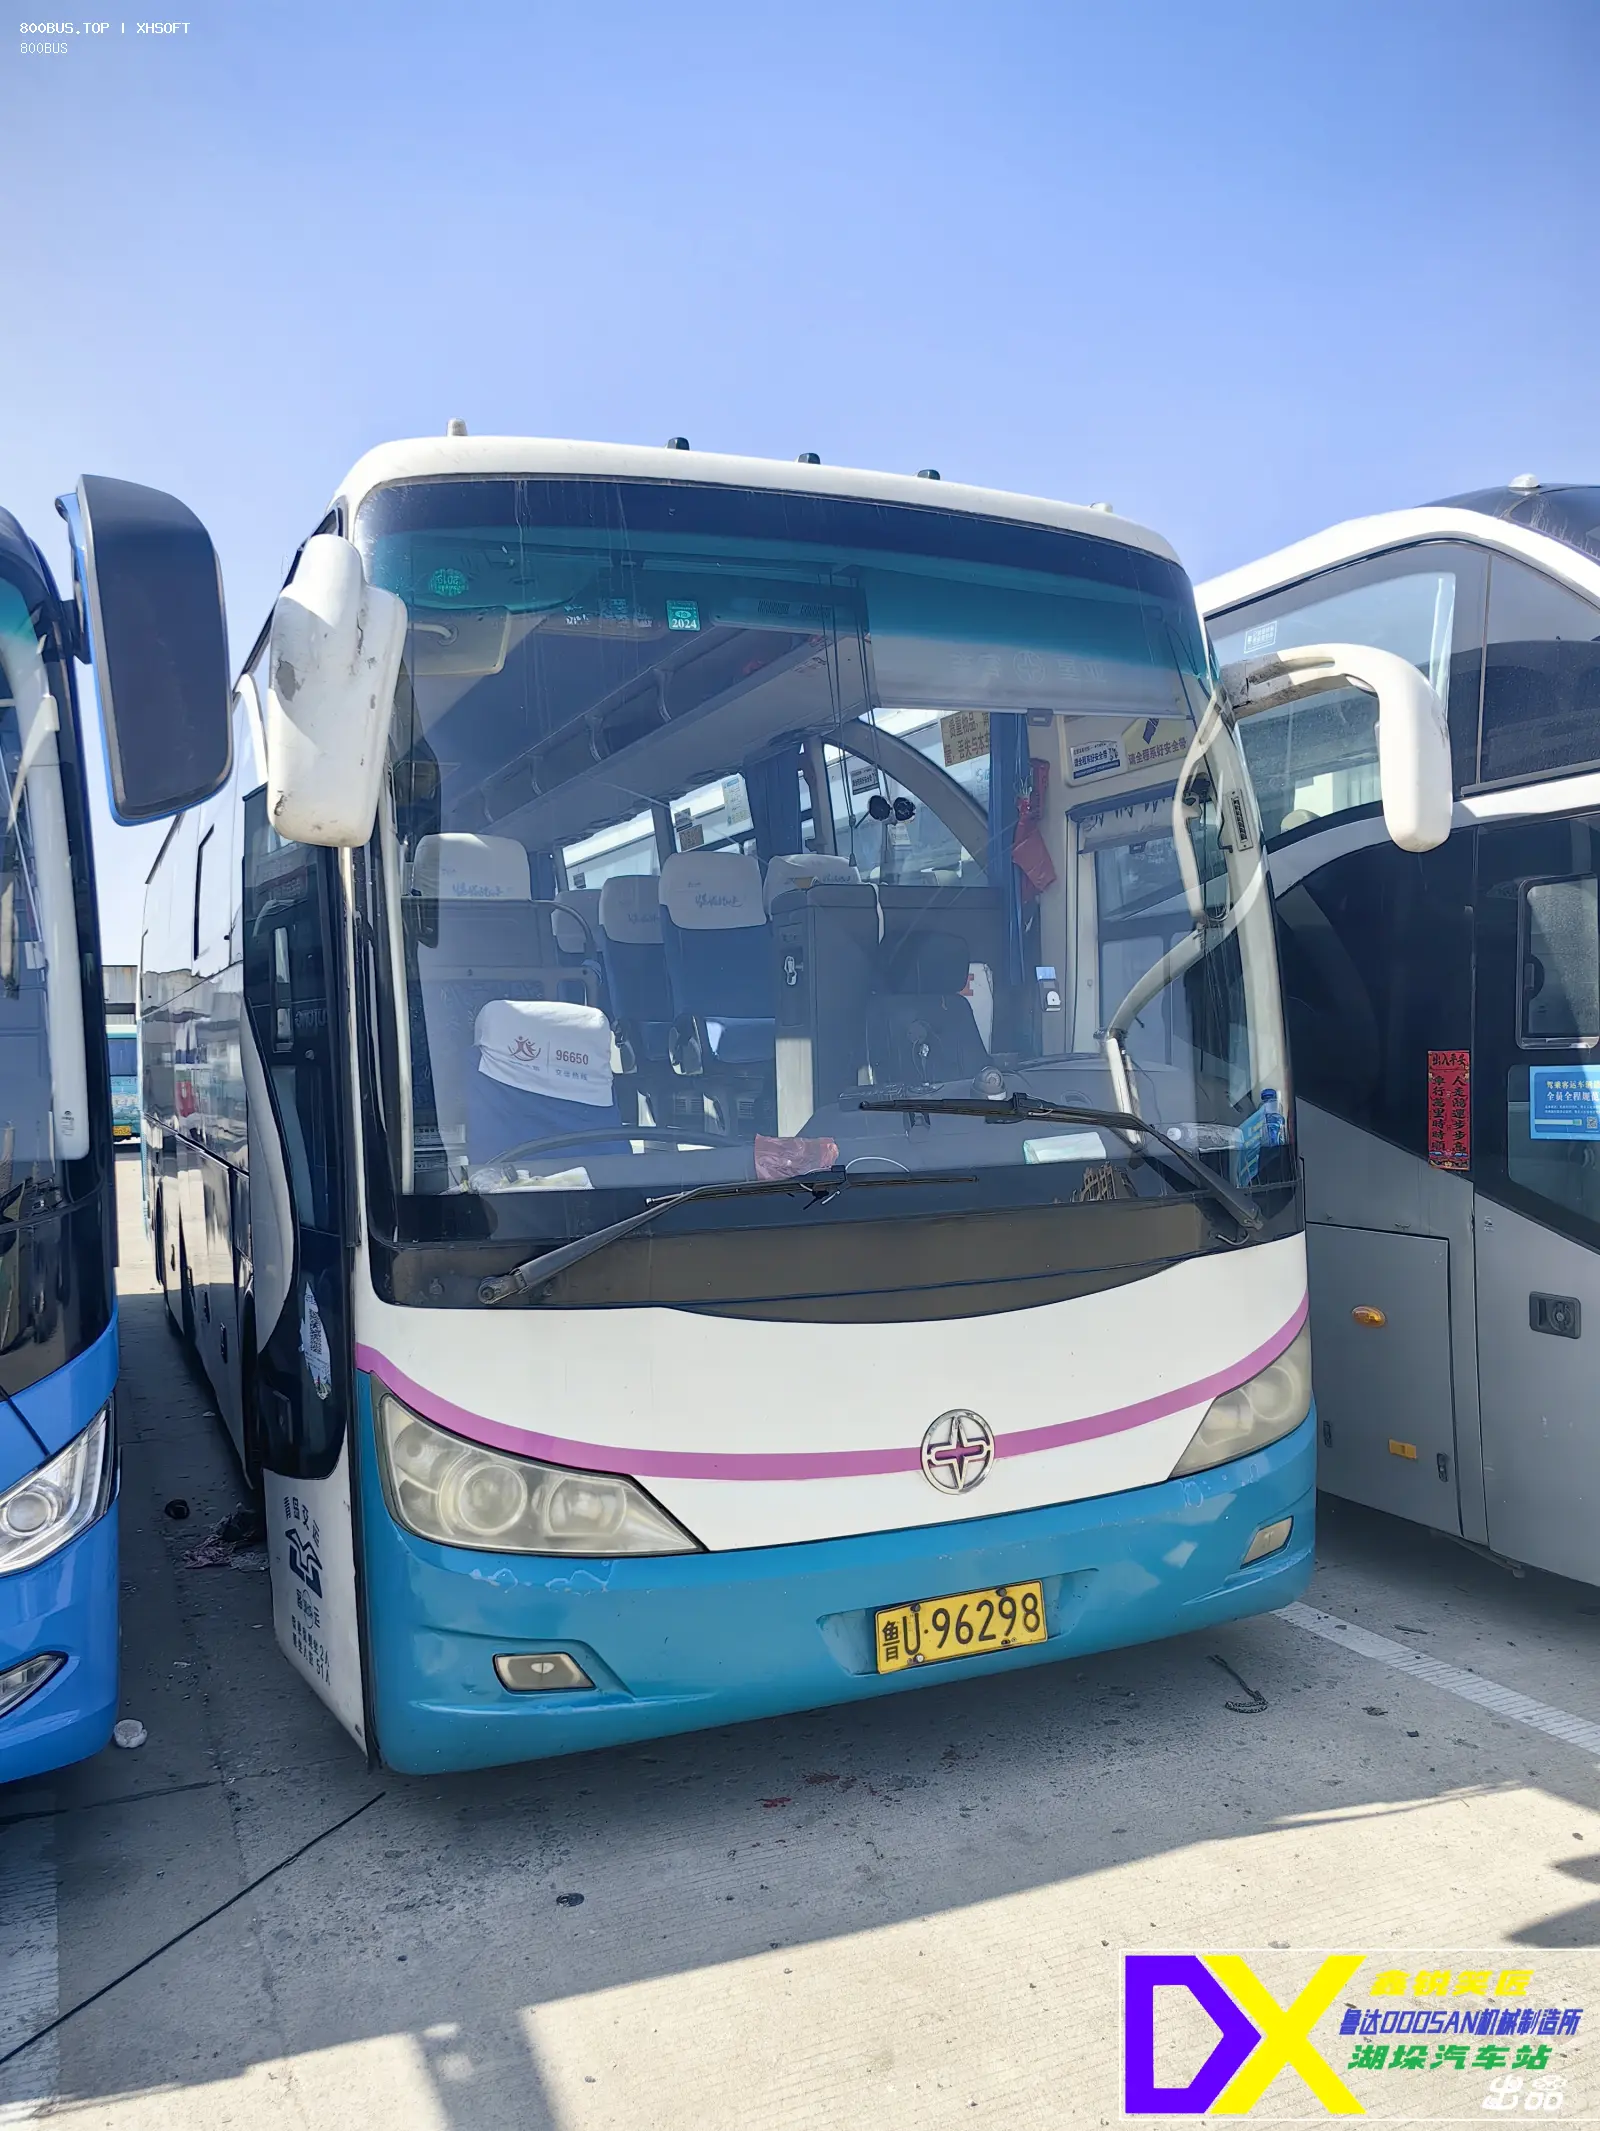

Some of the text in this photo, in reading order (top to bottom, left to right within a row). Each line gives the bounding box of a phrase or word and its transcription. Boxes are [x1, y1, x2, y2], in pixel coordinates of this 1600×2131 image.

[671, 618, 697, 629] 2024
[1128, 736, 1187, 765] 请全程系好安全带
[556, 1049, 589, 1065] 96650
[1432, 1053, 1466, 1067] 出入平安
